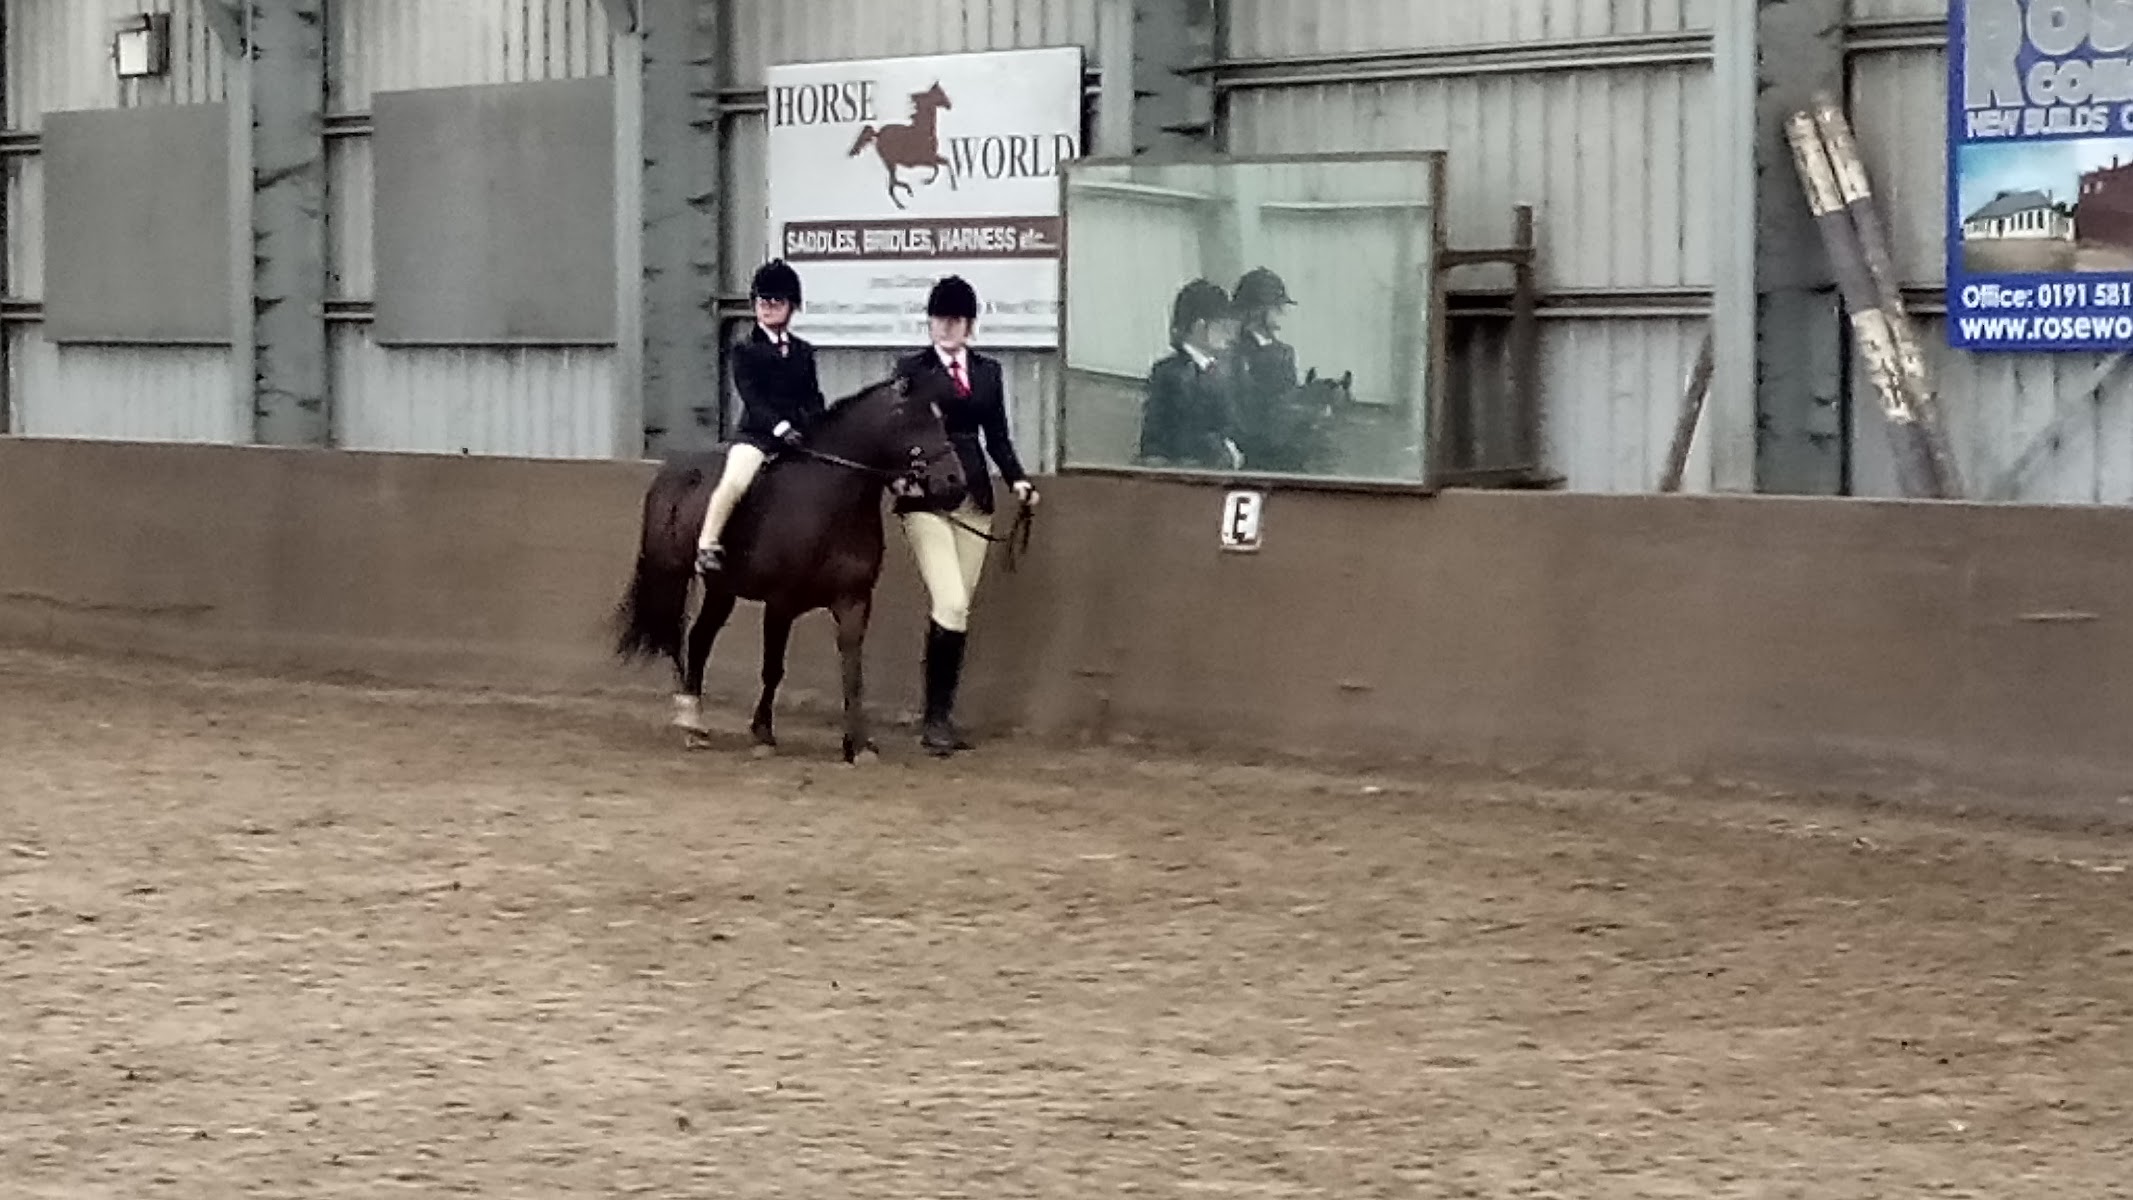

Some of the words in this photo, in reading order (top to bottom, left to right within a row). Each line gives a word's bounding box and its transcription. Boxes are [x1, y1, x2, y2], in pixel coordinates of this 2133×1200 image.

[774, 80, 877, 127] HORSE
[1966, 107, 2021, 138] NEW
[2023, 104, 2110, 136] BUILDS
[949, 133, 1076, 179] WORLD
[787, 229, 861, 255] SADDLES,
[938, 225, 1017, 252] HARNESS
[1962, 283, 2034, 309] Office:
[2038, 283, 2087, 308] 0191
[2093, 282, 2132, 307] 581
[1959, 315, 2133, 341] www.rosewo
[1231, 496, 1252, 541] E
